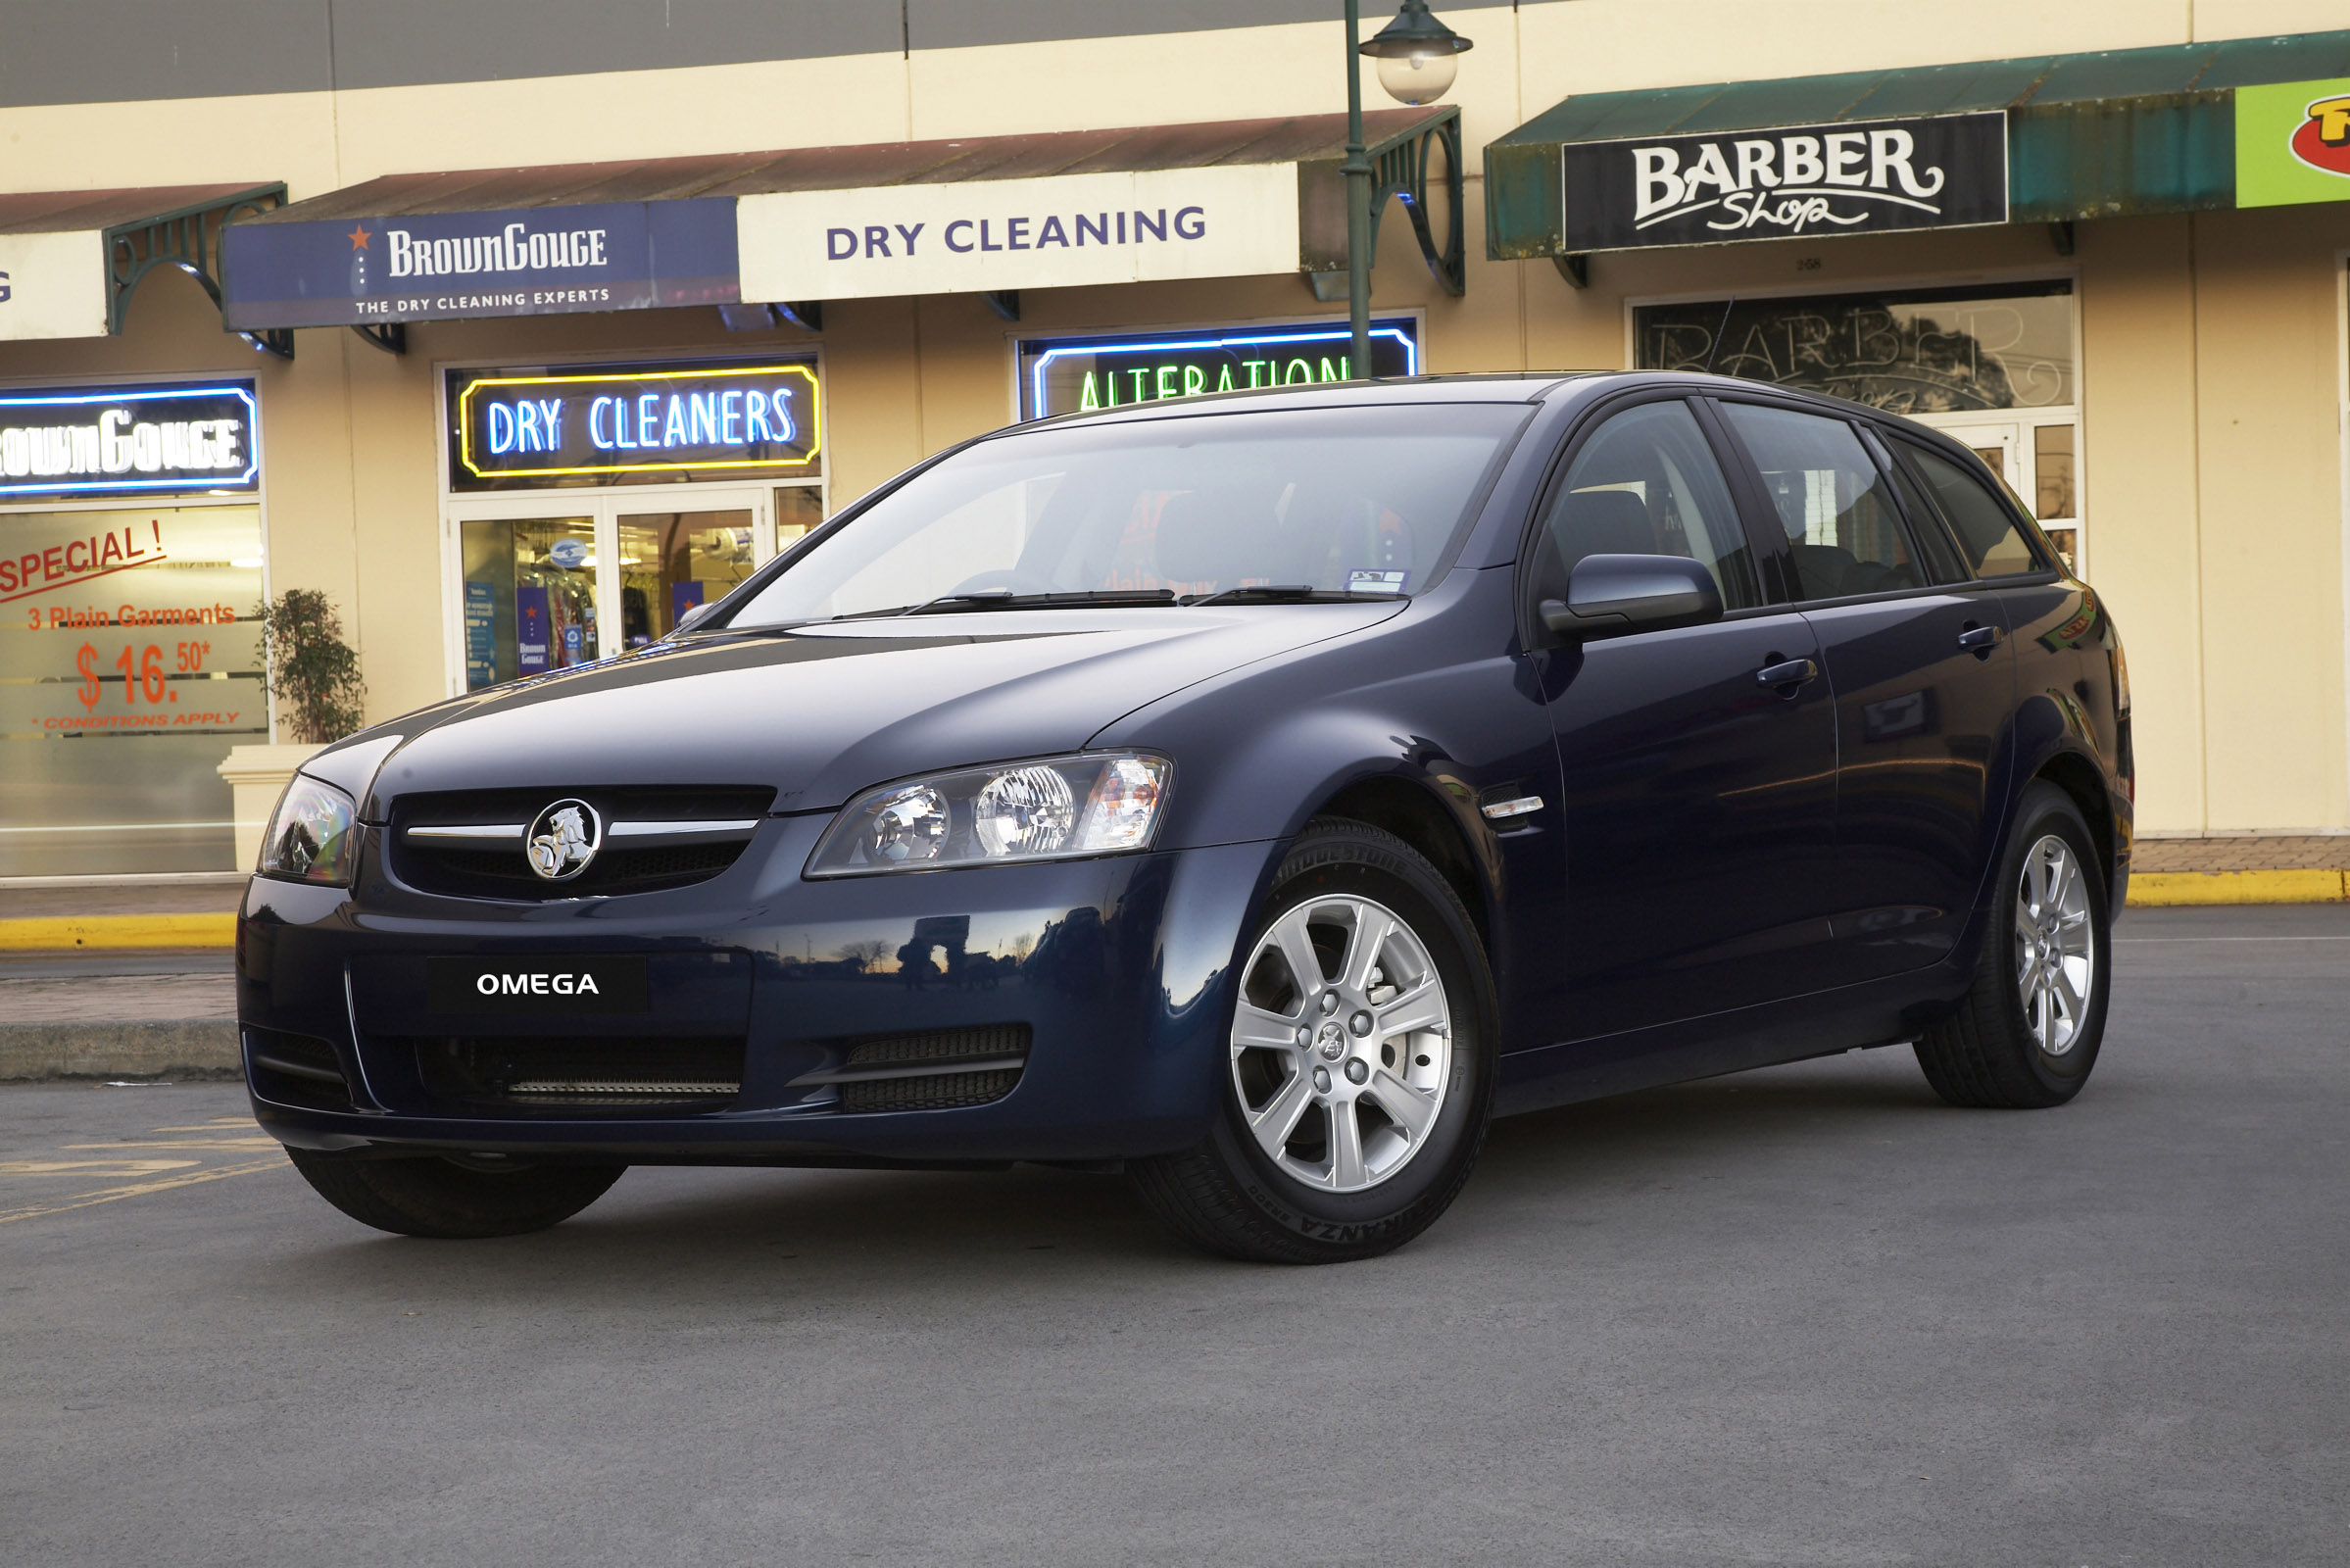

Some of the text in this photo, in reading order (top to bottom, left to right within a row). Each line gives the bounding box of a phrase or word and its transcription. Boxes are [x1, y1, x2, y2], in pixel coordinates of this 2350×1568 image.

[1631, 128, 1945, 221] BARBER
[1706, 190, 1869, 233] Shop
[826, 206, 1207, 262] DRY CLEANING
[356, 288, 610, 315] THE DRY CLEANING EXPERTS
[489, 388, 793, 455] DRY CLEANERS
[27, 602, 236, 631] 3 Plain Garments
[44, 711, 240, 730] CONDITIONS APPLY
[476, 973, 600, 996] OMEGA
